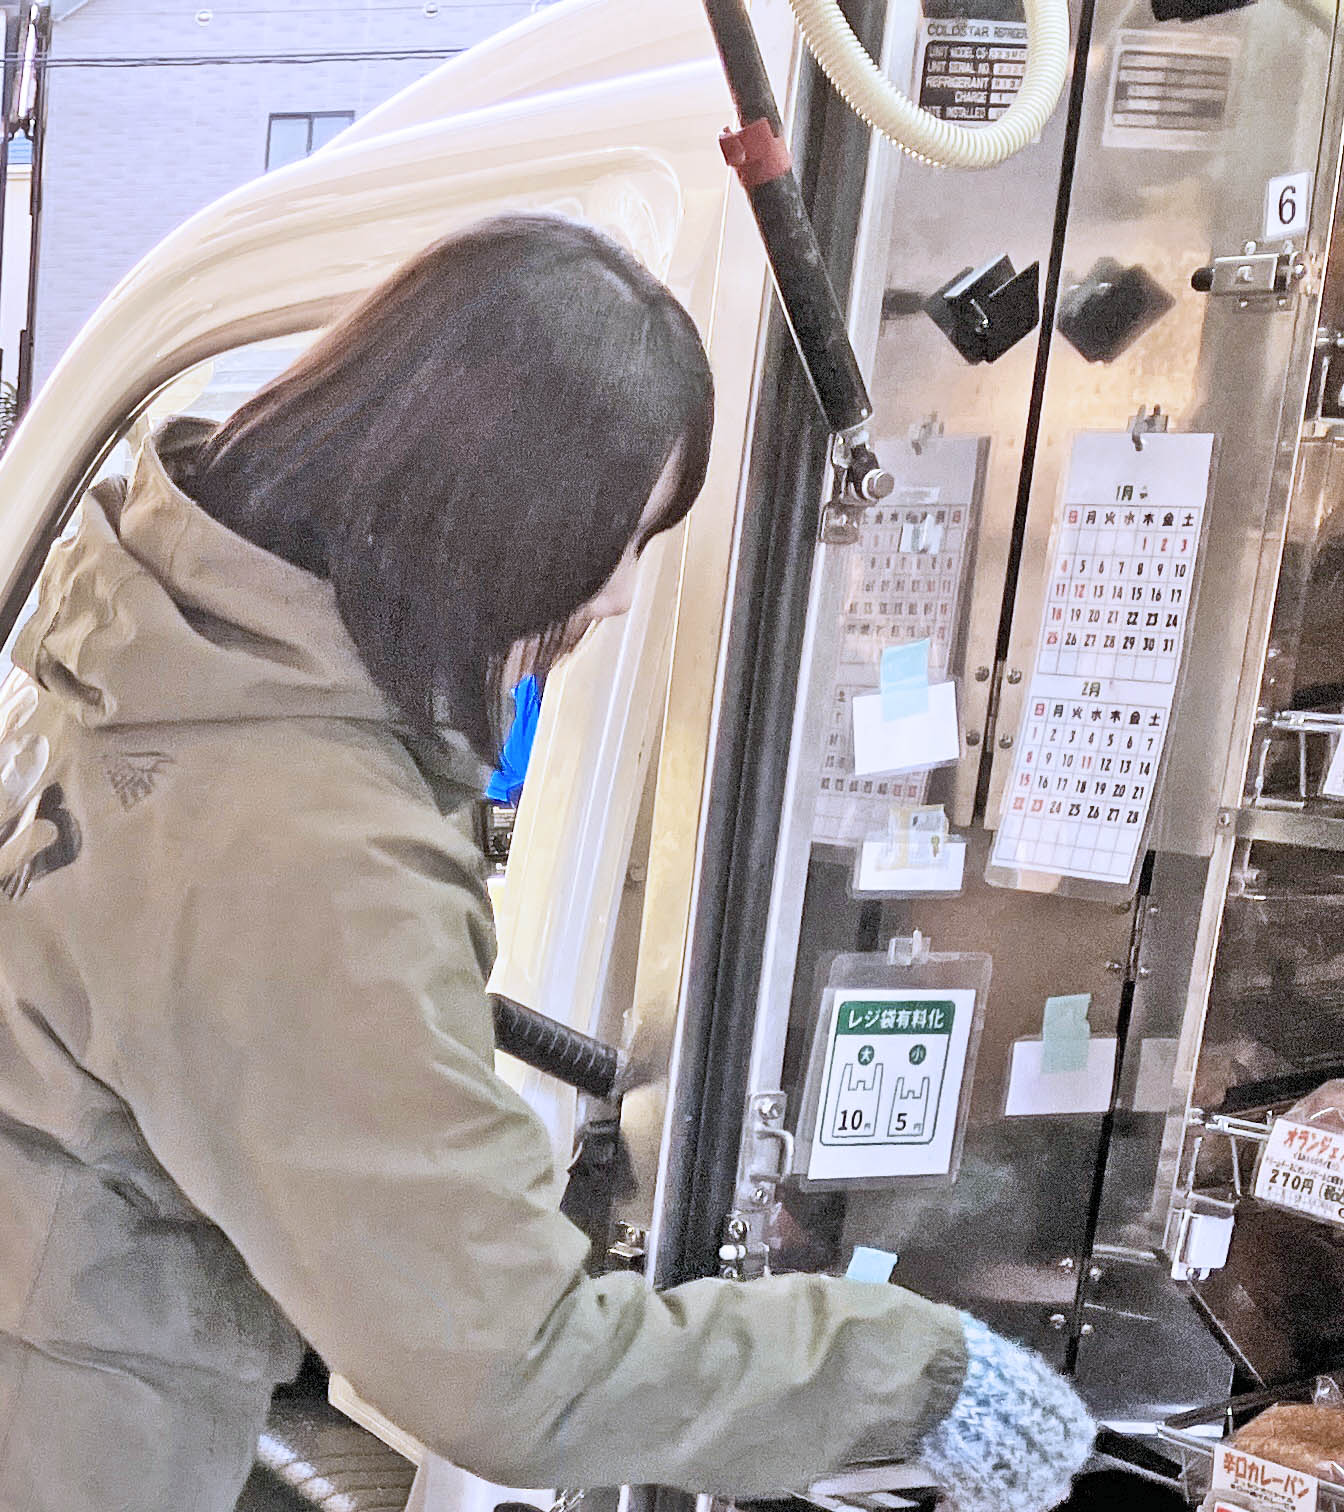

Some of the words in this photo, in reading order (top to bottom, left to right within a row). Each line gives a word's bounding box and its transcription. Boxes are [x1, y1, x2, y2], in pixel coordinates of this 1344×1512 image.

[1278, 185, 1297, 225] 6
[1069, 511, 1077, 523] 日
[1086, 511, 1096, 524] 月
[1105, 512, 1115, 524] 火
[1124, 512, 1135, 525] 水
[1143, 512, 1153, 526] 木
[1162, 512, 1174, 526] 金
[1182, 513, 1194, 527] 土
[1143, 537, 1146, 549] 1
[1161, 538, 1168, 551] 2
[1181, 539, 1188, 552] 3
[1080, 560, 1086, 573] 5
[1099, 561, 1104, 573] 6
[1119, 562, 1124, 574] 7
[1137, 563, 1143, 575] 8
[1157, 563, 1163, 576] 9
[1175, 564, 1186, 577] 10
[1056, 584, 1065, 596] 11
[1074, 585, 1084, 598] 12
[1093, 585, 1104, 598] 13
[1112, 586, 1122, 599] 14
[1132, 587, 1142, 600] 15
[1151, 588, 1161, 601] 16
[1171, 589, 1182, 602] 17
[1052, 607, 1062, 620] 18
[1071, 609, 1081, 621] 19
[1088, 610, 1100, 622] 20
[1107, 611, 1118, 623] 21
[1127, 612, 1138, 625] 22
[1146, 613, 1158, 626] 23
[1166, 614, 1178, 627] 24
[1047, 632, 1057, 644] 25
[1065, 633, 1076, 645] 26
[1084, 634, 1096, 646] 27
[1104, 635, 1115, 648] 28
[1123, 636, 1135, 649] 29
[1143, 637, 1155, 651] 30
[1163, 638, 1174, 651] 31
[1082, 682, 1100, 697] 2月
[1035, 703, 1044, 716] 日
[1053, 704, 1063, 717] 月
[1072, 706, 1082, 719] 火
[1092, 708, 1102, 721] 水
[1111, 710, 1121, 723] 木
[1129, 711, 1140, 724] 金
[1149, 713, 1160, 726] 土
[1033, 728, 1037, 739] 1
[1050, 729, 1056, 741] 2
[1069, 731, 1076, 743] 3
[1089, 732, 1094, 744] 4
[1107, 734, 1114, 746] 5
[1127, 736, 1132, 748] 6
[1147, 738, 1153, 751] 7
[1026, 752, 1032, 763] 8
[1046, 752, 1052, 764] 9
[1063, 754, 1073, 767] 10
[1081, 756, 1091, 768] 11
[1101, 758, 1111, 771] 12
[1120, 760, 1131, 773] 13
[1139, 762, 1150, 775] 14
[1019, 774, 1030, 786] 15
[1039, 776, 1048, 788] 16
[1057, 778, 1067, 790] 17
[1076, 780, 1086, 793] 18
[1095, 782, 1106, 795] 19
[1113, 785, 1125, 797] 20
[1132, 786, 1144, 799] 21
[1050, 801, 1061, 813] 24
[1068, 804, 1081, 816] 25
[1087, 806, 1100, 818] 26
[1107, 808, 1119, 822] 27
[1127, 811, 1139, 823] 28
[848, 1008, 944, 1029] レジ袋有料化
[1269, 1169, 1314, 1195] 270円
